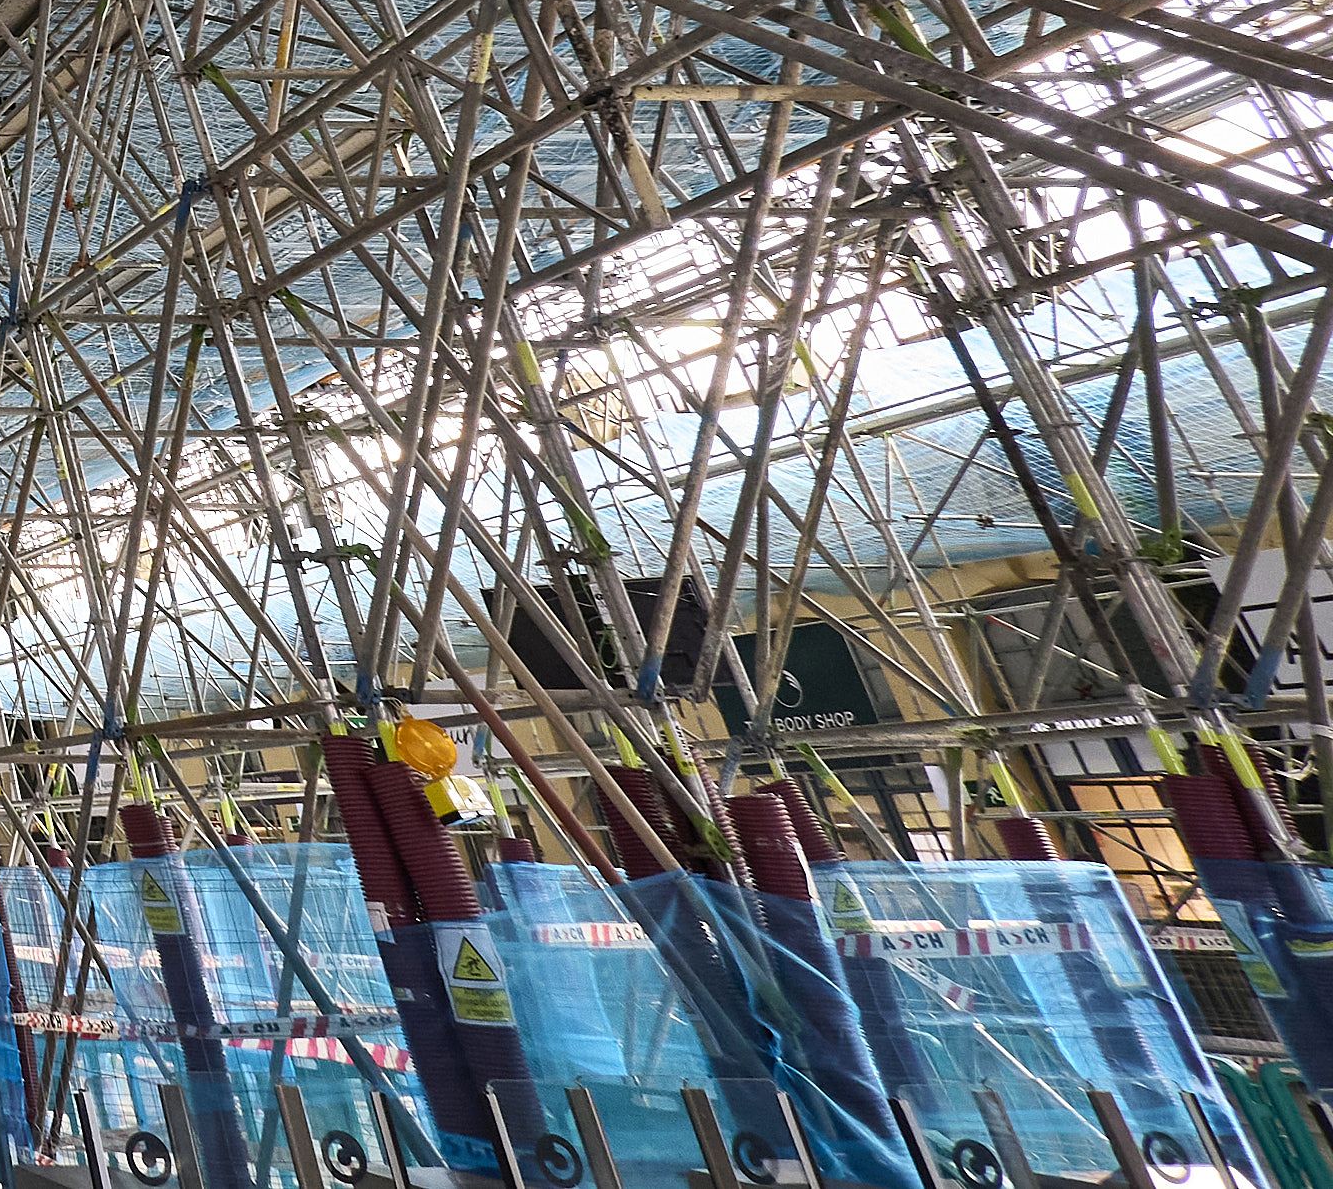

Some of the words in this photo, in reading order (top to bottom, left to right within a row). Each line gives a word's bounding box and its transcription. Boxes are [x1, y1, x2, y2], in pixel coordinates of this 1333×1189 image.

[775, 717, 812, 732] BODY
[813, 712, 854, 730] SHOP
[554, 927, 585, 939] ASCH
[616, 927, 647, 941] ASC
[881, 932, 944, 950] ASCH
[996, 926, 1050, 946] ASCH
